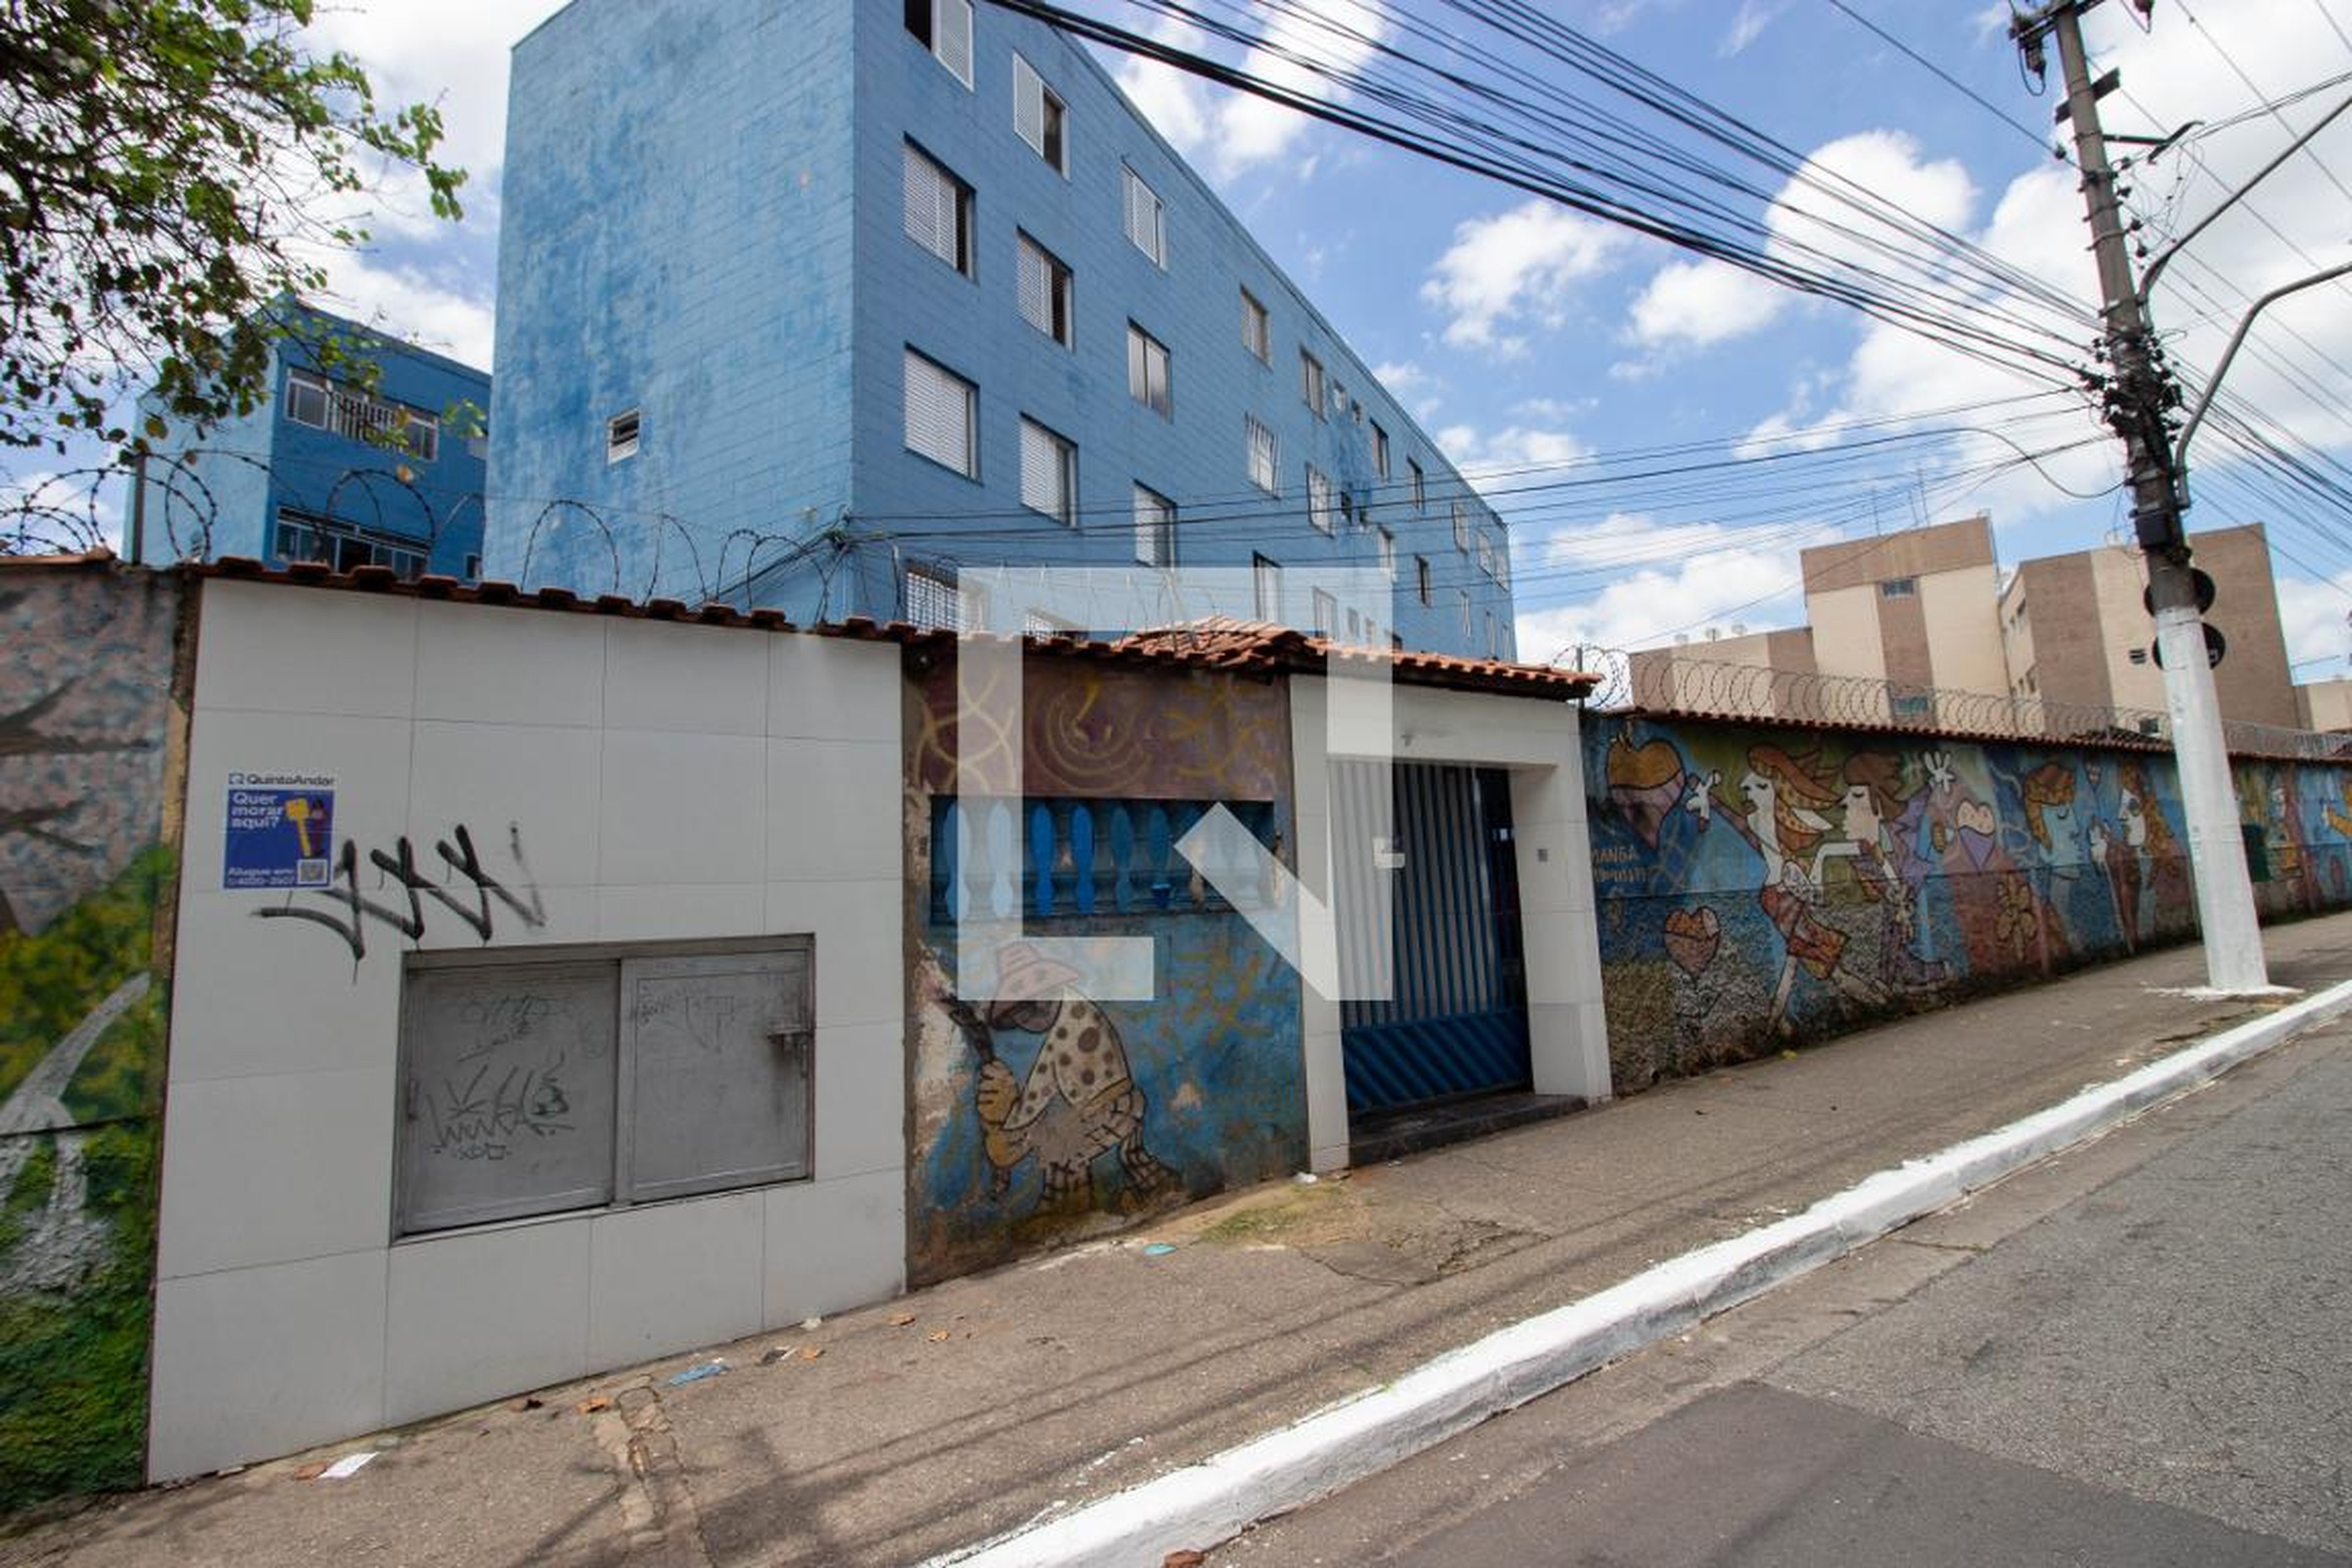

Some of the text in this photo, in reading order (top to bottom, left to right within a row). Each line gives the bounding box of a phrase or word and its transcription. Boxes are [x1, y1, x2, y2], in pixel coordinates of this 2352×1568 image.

[247, 773, 335, 785] QuintoAndar
[232, 792, 278, 805] Quer
[232, 806, 284, 816] morar
[232, 816, 279, 829] aqui?
